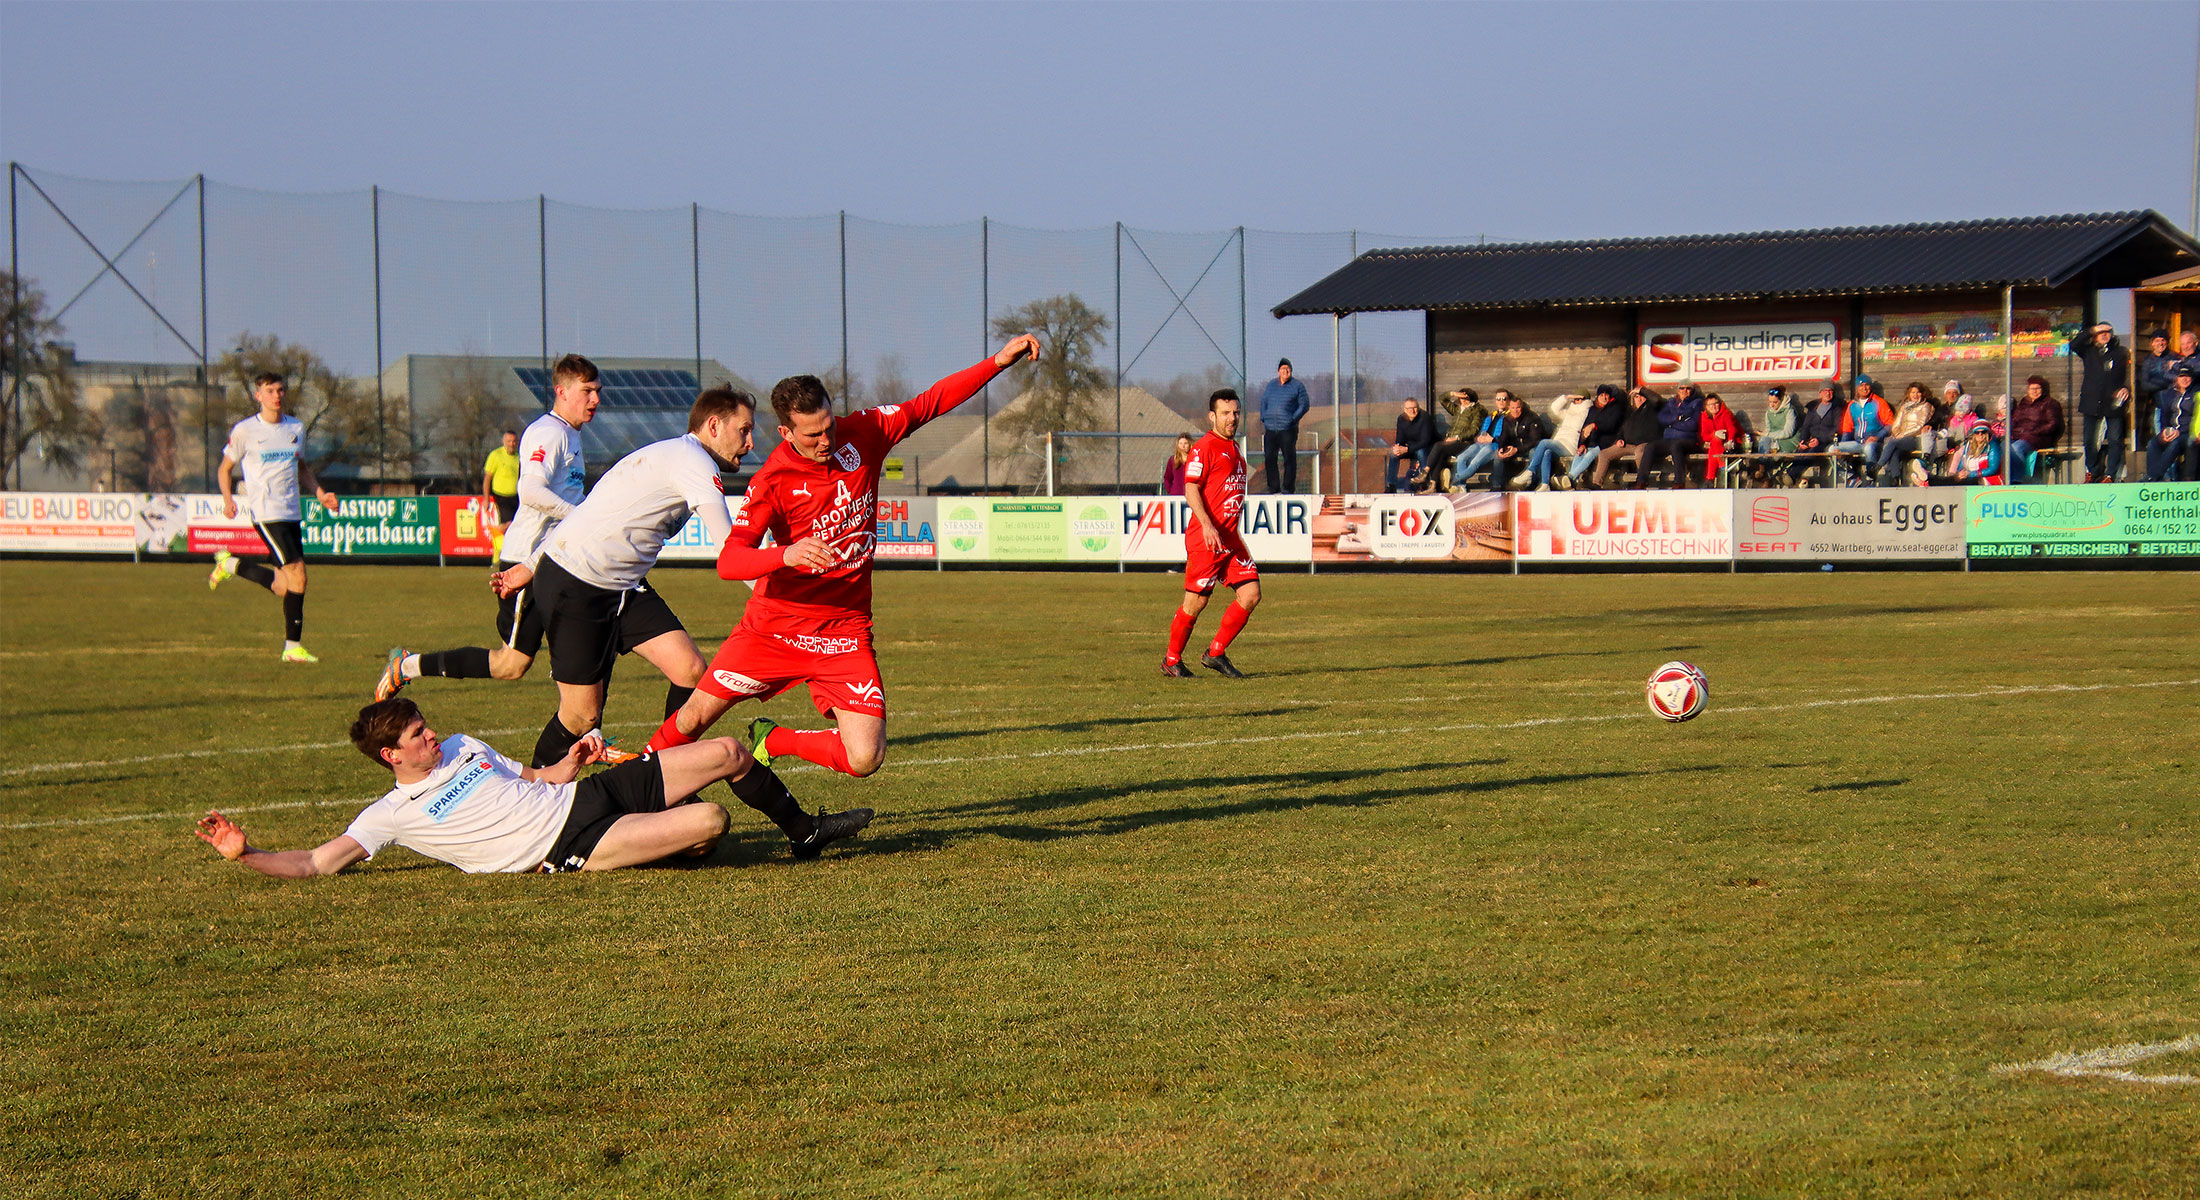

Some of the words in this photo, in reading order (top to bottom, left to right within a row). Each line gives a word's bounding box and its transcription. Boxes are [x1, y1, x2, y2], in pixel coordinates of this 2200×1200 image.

[1694, 331, 1831, 353] staudinger
[1694, 354, 1831, 372] baumarkt
[2139, 487, 2200, 501] Gerhard
[0, 498, 29, 520] EU
[33, 498, 73, 520] BAU
[77, 497, 133, 520] BÜRO
[812, 489, 874, 530] APOTHEKE
[877, 501, 908, 520] CH
[1879, 498, 1958, 532] Egger
[2124, 505, 2200, 519] Tiefenthal
[943, 521, 984, 530] STRASSER
[1073, 521, 1115, 530] STRASSER
[1381, 508, 1444, 537] FOX
[2124, 524, 2153, 535] 0664
[2162, 523, 2181, 535] 152
[2185, 523, 2197, 535] 12
[300, 517, 436, 552] nappenbauer
[877, 522, 935, 542] ELLA
[1740, 542, 1802, 552] SEAT
[1810, 543, 1829, 552] 4552
[1832, 542, 1874, 554] Wartberg,
[1877, 543, 1959, 555] www.seat-egger.at
[1971, 544, 2032, 556] BERATEN
[2044, 543, 2129, 555] VERSICHERN
[797, 634, 858, 646] TOPDACH
[429, 767, 484, 816] SPARKASSE
